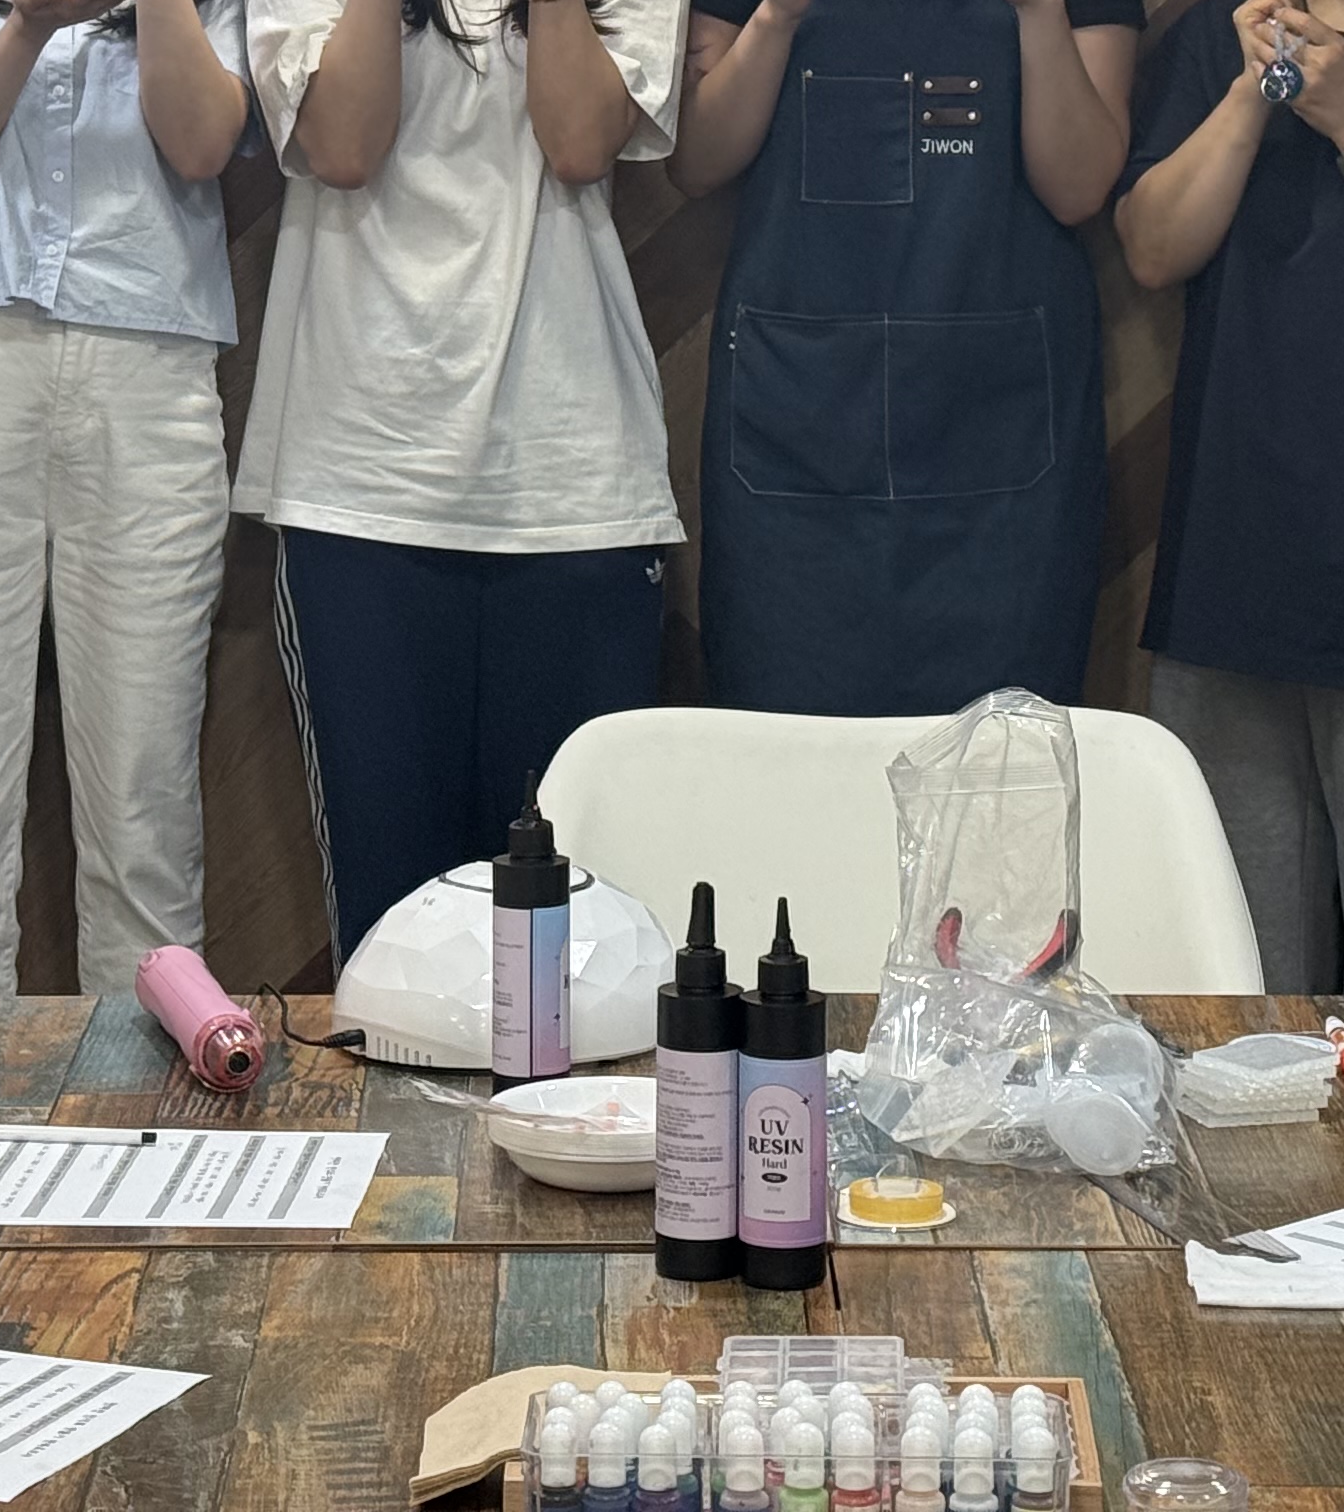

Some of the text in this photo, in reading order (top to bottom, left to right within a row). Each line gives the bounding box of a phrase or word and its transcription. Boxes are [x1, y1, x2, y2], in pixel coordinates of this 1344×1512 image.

[920, 138, 974, 155] JIWON
[759, 1118, 789, 1136] UV
[747, 1135, 804, 1155] RESIN
[761, 1157, 788, 1170] Hard
